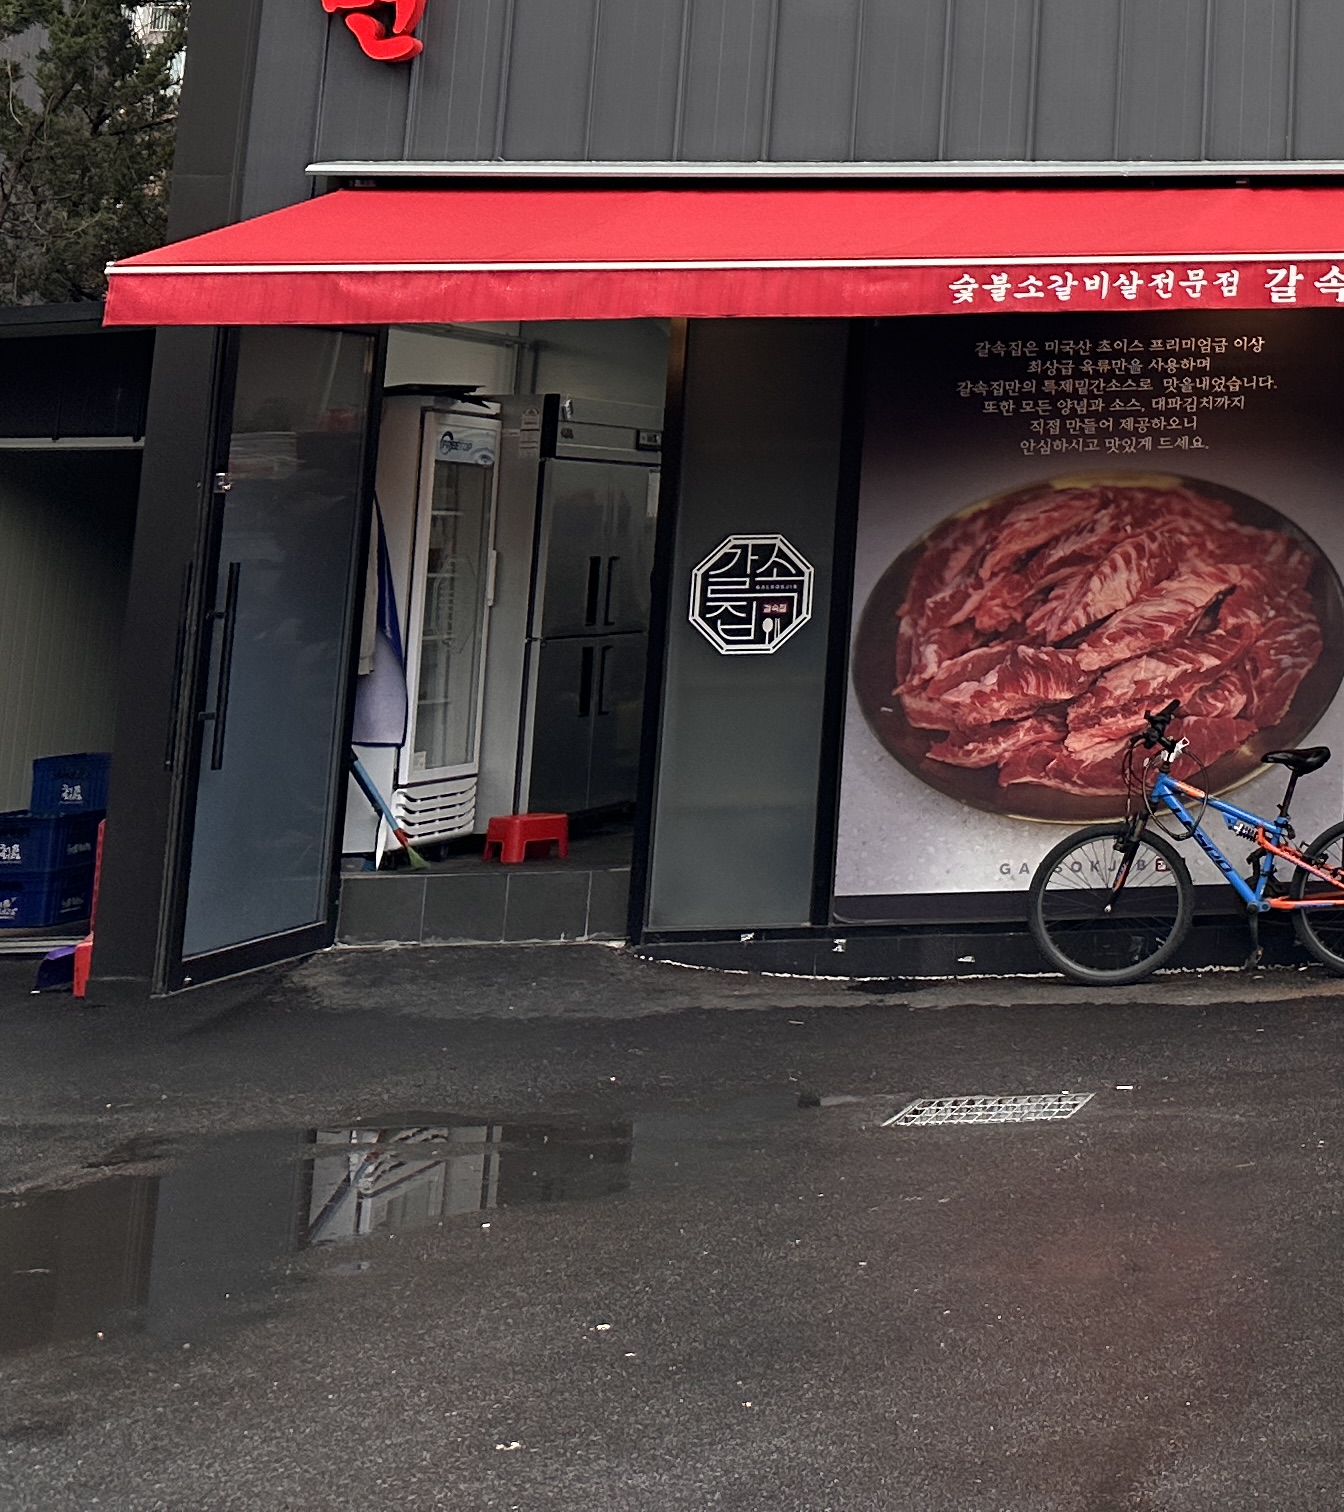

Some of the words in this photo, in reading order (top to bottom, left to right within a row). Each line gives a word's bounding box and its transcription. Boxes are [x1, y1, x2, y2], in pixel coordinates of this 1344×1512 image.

[948, 268, 1240, 304] 숯불소갈비살전문점
[975, 340, 1039, 357] 갈속집은
[1045, 340, 1092, 356] 미국산
[1096, 338, 1144, 353] 초이스
[1149, 338, 1228, 353] 프리미엄급
[1234, 337, 1265, 352] 이상
[1027, 360, 1075, 375] 최상급
[1148, 357, 1211, 373] 사용하며
[957, 380, 1036, 397] 갈속집만의
[983, 400, 1016, 416] 또한
[1020, 400, 1052, 415] 모든
[1057, 398, 1105, 415] 양념과
[1152, 396, 1245, 412] 대파김치까지
[1030, 418, 1060, 435] 직접
[1066, 418, 1113, 434] 만들어
[1119, 416, 1196, 433] 제공하오니
[1020, 439, 1099, 455] 안심하시고
[1105, 436, 1152, 453] 맛있게
[1157, 436, 1209, 450] 드세요.
[1000, 860, 1146, 876] GASOKJB
